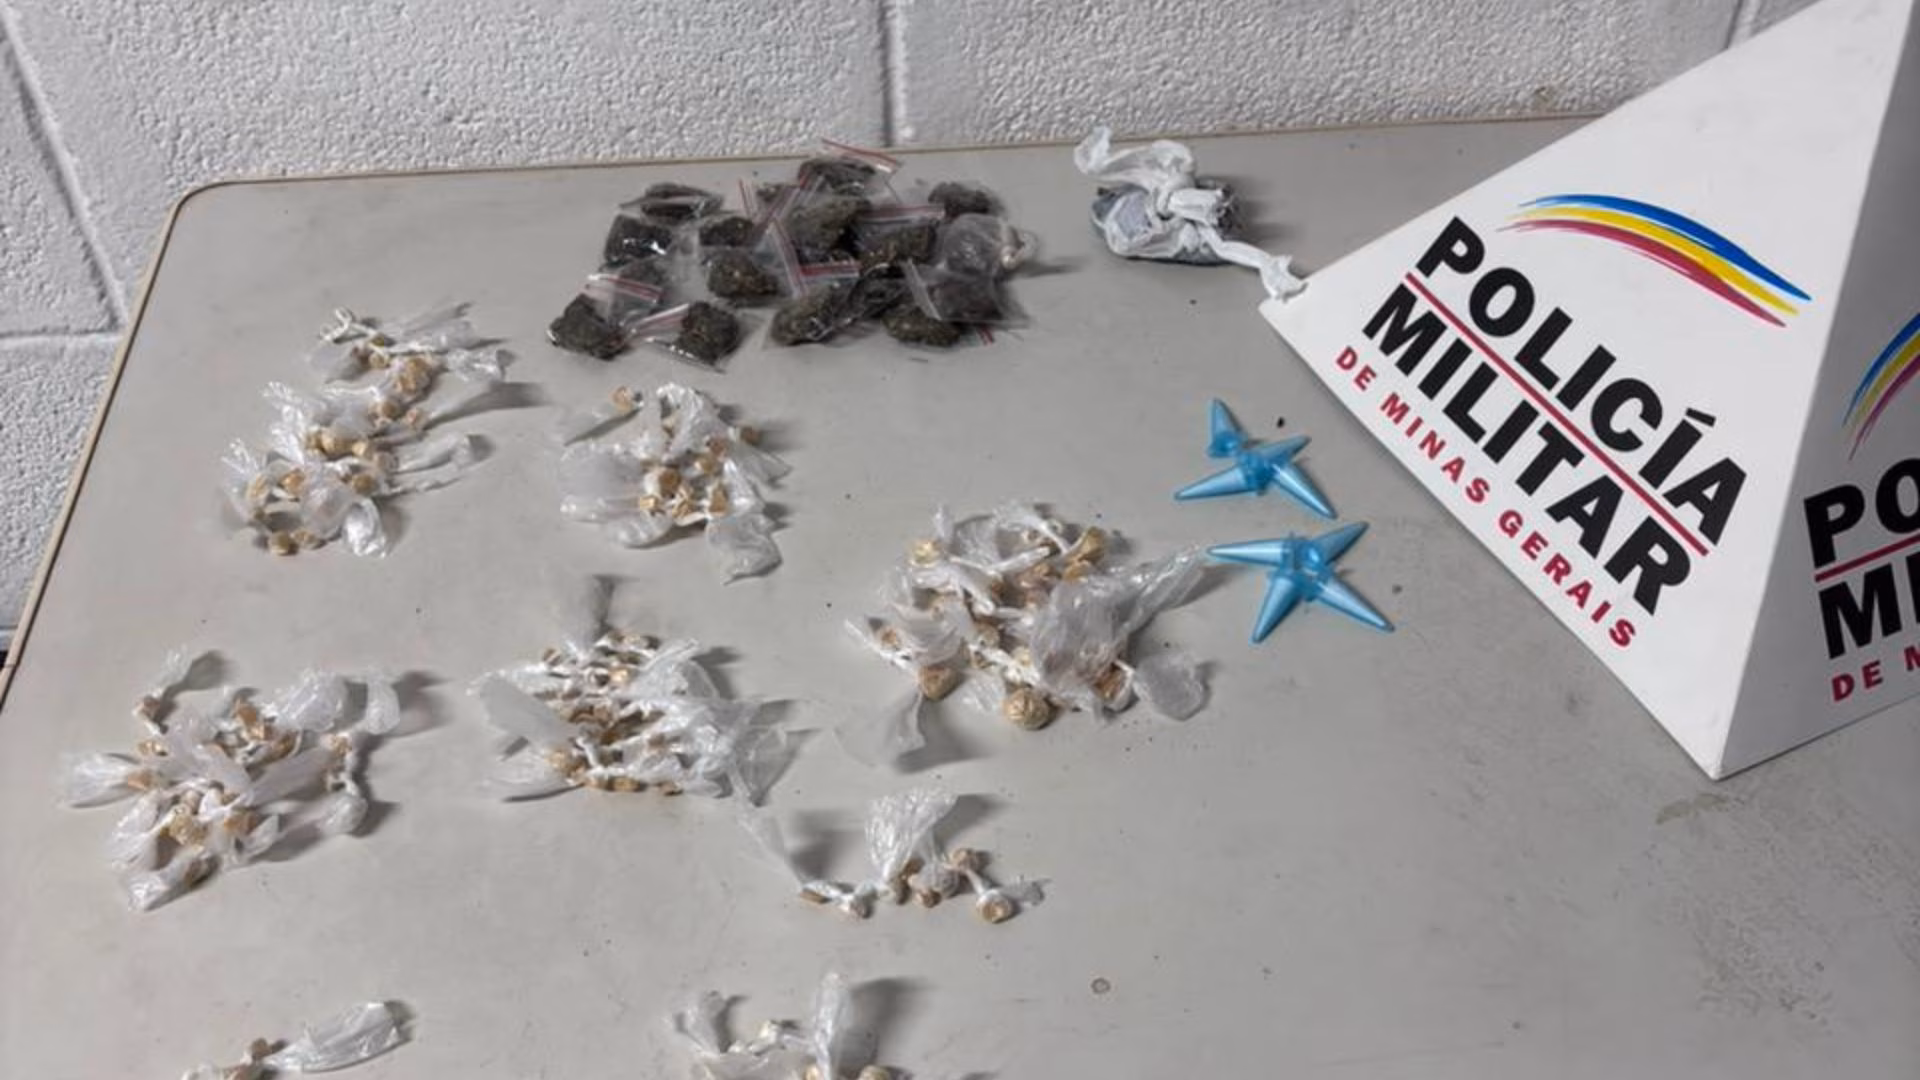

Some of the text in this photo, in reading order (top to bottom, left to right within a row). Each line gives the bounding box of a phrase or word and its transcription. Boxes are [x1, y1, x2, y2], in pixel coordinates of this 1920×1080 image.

[1335, 346, 1638, 648] DE MINAS GERAIS
[1362, 283, 1692, 616] MILITAR
[1415, 216, 1748, 546] POLICÍA
[1831, 660, 1884, 702] DE
